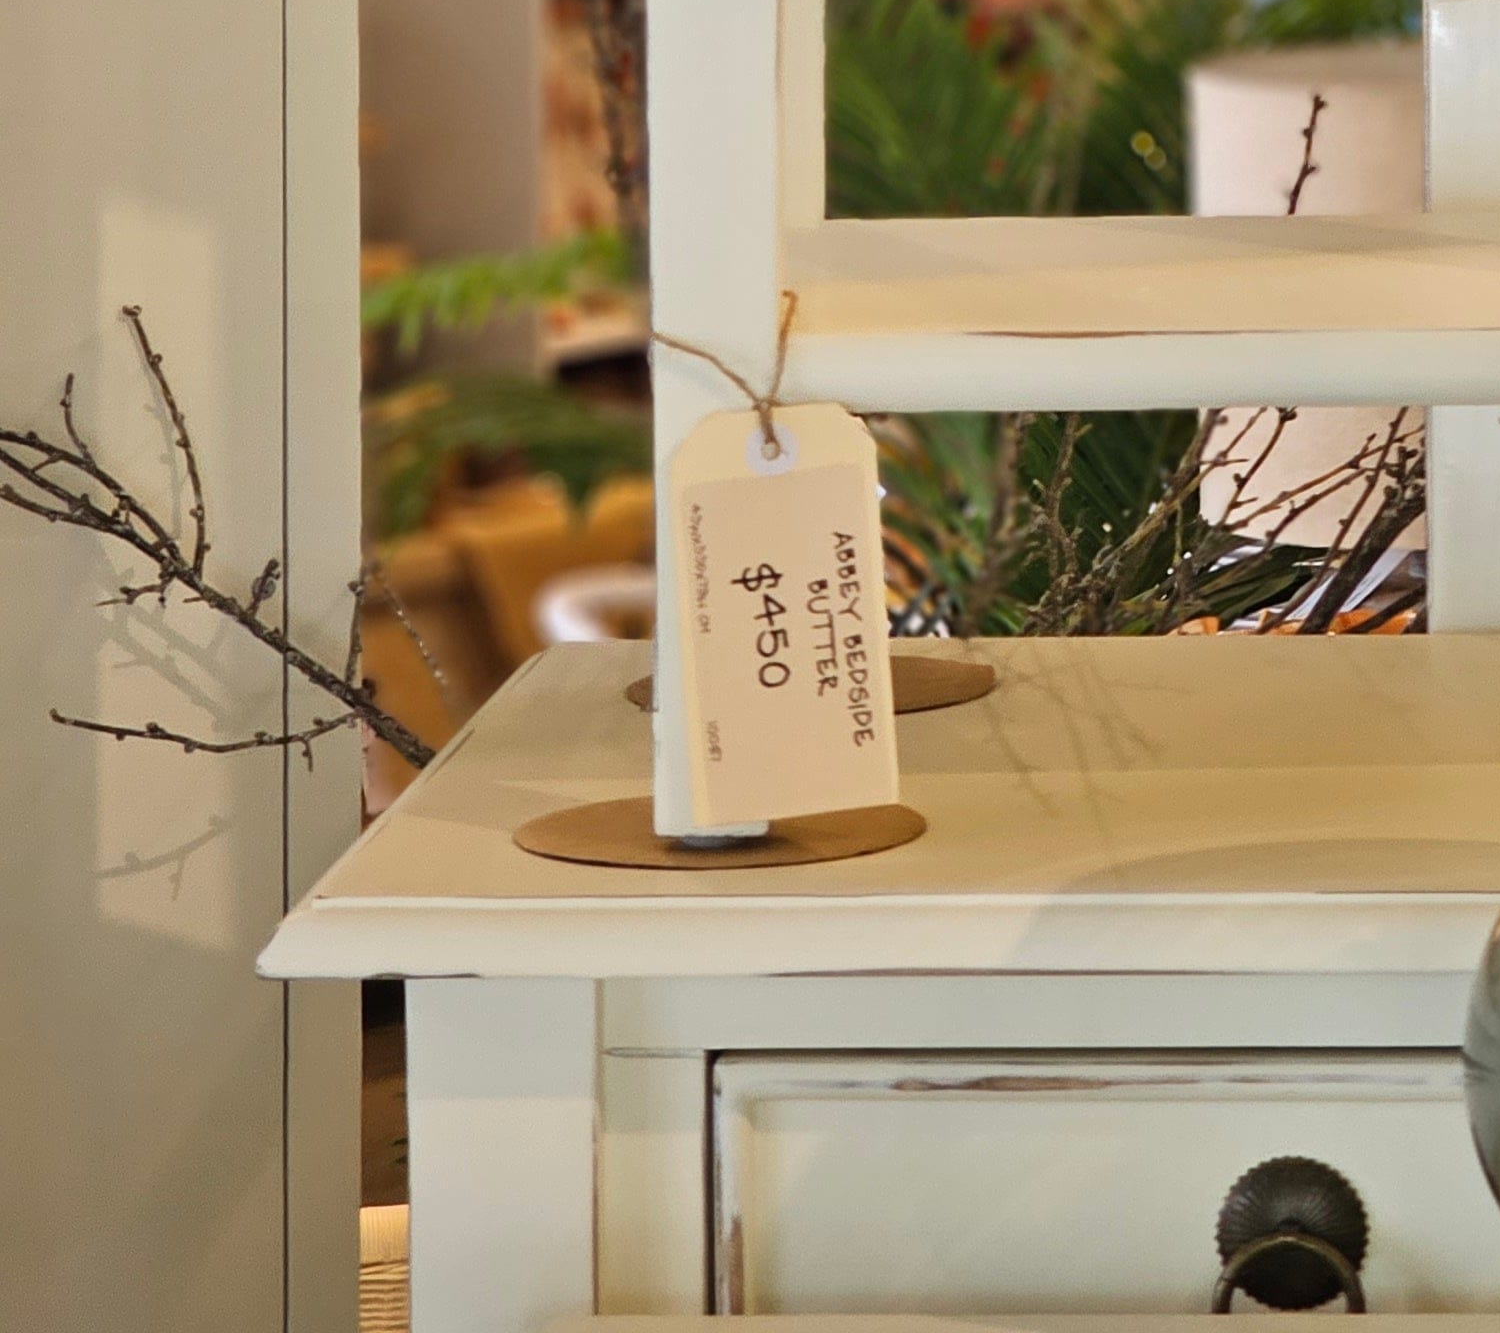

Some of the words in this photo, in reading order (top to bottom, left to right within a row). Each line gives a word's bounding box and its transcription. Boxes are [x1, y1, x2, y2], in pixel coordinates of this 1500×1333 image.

[730, 562, 791, 688] $450
[833, 531, 862, 622] ABBEY
[806, 578, 838, 696] BUTTER
[843, 633, 875, 748] BEDSIDE
